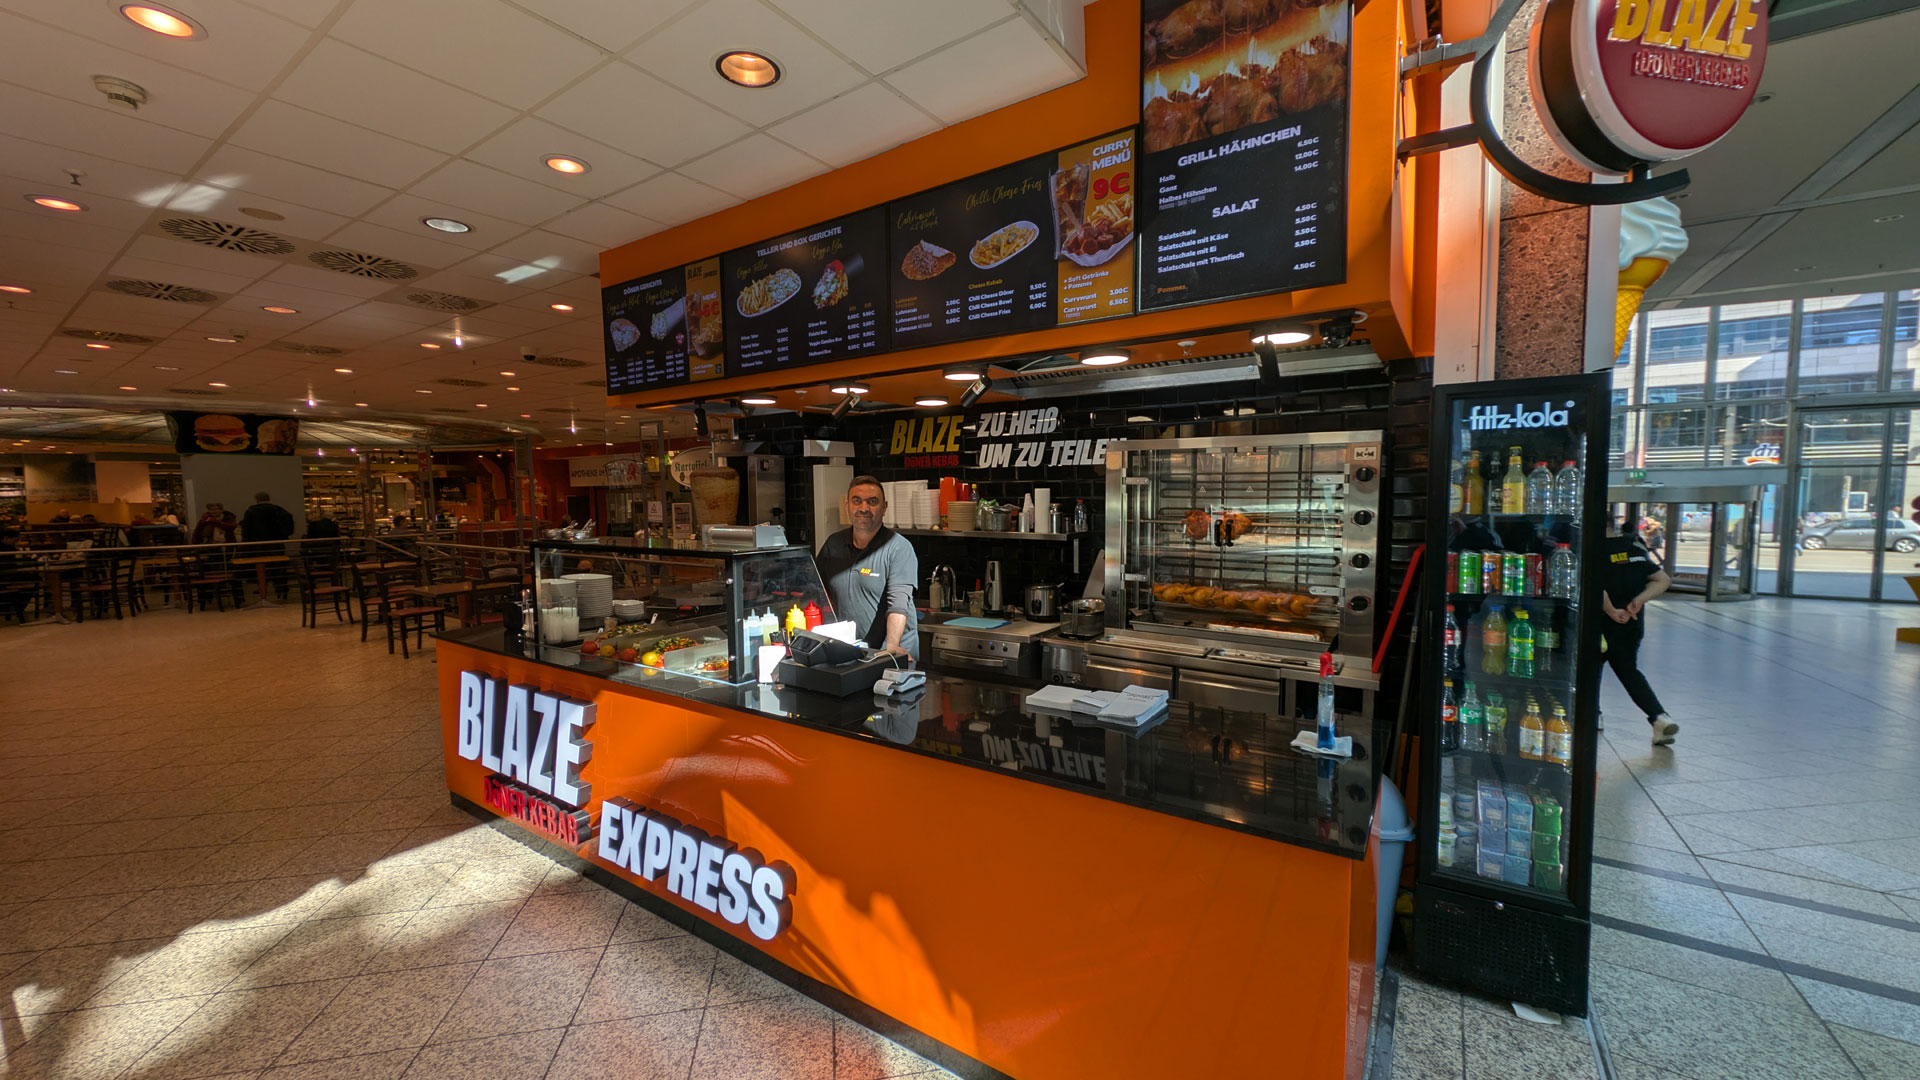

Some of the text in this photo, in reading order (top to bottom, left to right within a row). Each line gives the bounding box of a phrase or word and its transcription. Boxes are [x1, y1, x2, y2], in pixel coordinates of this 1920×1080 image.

[1608, 0, 1759, 60] BLAZE
[1697, 56, 1750, 89] KEBAB
[1092, 137, 1132, 157] CURRY
[1178, 125, 1302, 167] GRILL HÄHNCHEN
[1092, 148, 1131, 171] MENÜ
[1159, 174, 1176, 183] Halb
[1159, 185, 1177, 194] Ganz
[1159, 194, 1182, 204] Halbes
[1183, 186, 1218, 199] Hähnchen
[1212, 198, 1260, 219] SALAT
[756, 245, 780, 257] TELLER
[780, 241, 792, 250] UND
[808, 226, 842, 243] GERICHTE
[1158, 229, 1197, 242] Salatschale
[1158, 233, 1229, 253] Salatschale mit Käse
[1157, 251, 1196, 263] Salatschale
[1157, 261, 1196, 273] Salatschale
[1209, 251, 1245, 263] Thunfisch
[1081, 271, 1109, 280] Getränke
[1063, 293, 1097, 304] Currywurst
[1063, 303, 1097, 314] Currywurst
[889, 415, 965, 455] BLAZE
[977, 412, 1006, 438] ZU
[932, 454, 960, 468] KEBAB
[979, 437, 1127, 468] UM ZU TEILE
[458, 670, 588, 807] BLAZE
[483, 775, 580, 846] DÖNER KEBAB
[598, 800, 785, 941] EXPRESS
